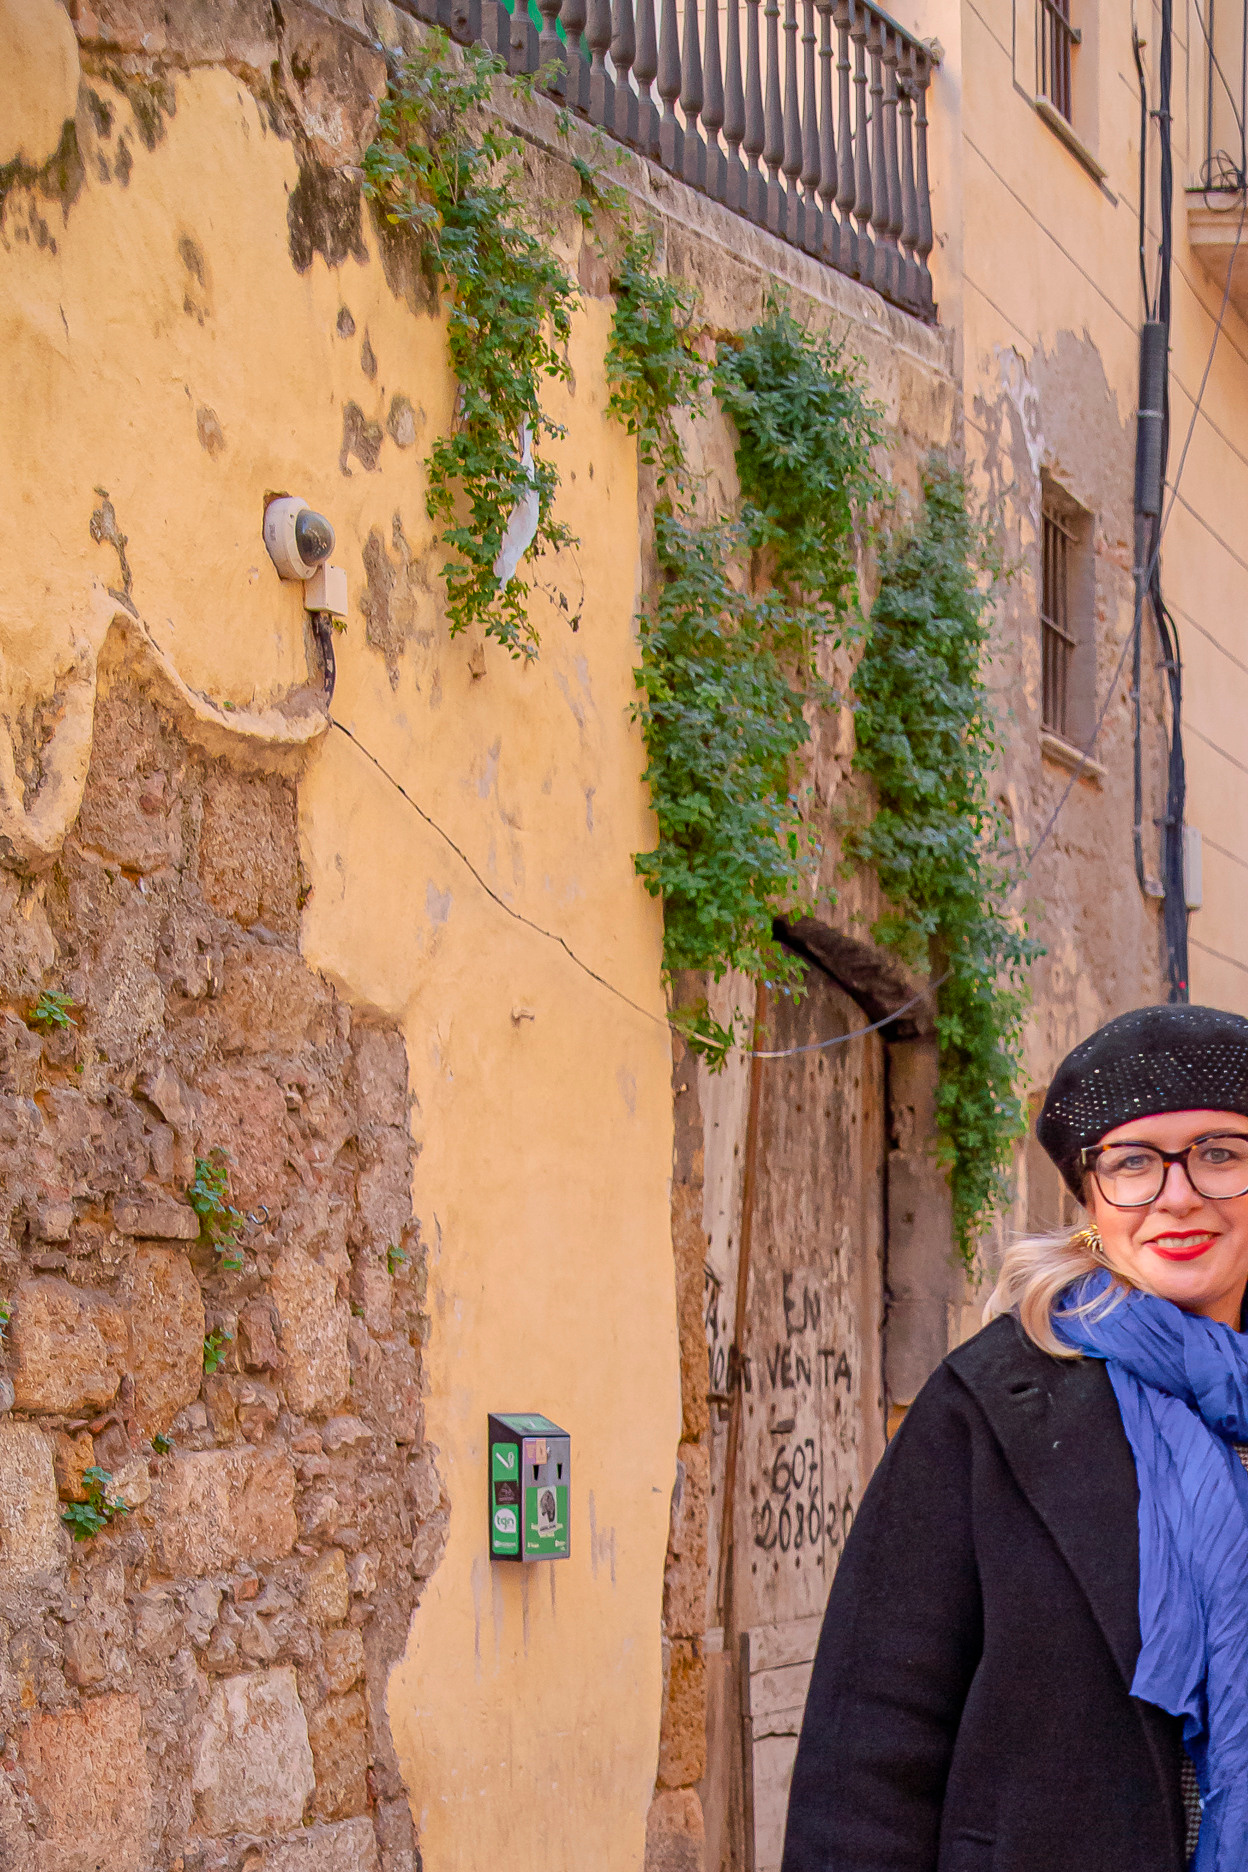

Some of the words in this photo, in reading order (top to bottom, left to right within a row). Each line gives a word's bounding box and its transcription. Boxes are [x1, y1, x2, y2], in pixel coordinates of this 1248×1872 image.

[783, 1271, 821, 1339] EN
[767, 1342, 852, 1394] VENTA
[772, 1438, 818, 1495] 607
